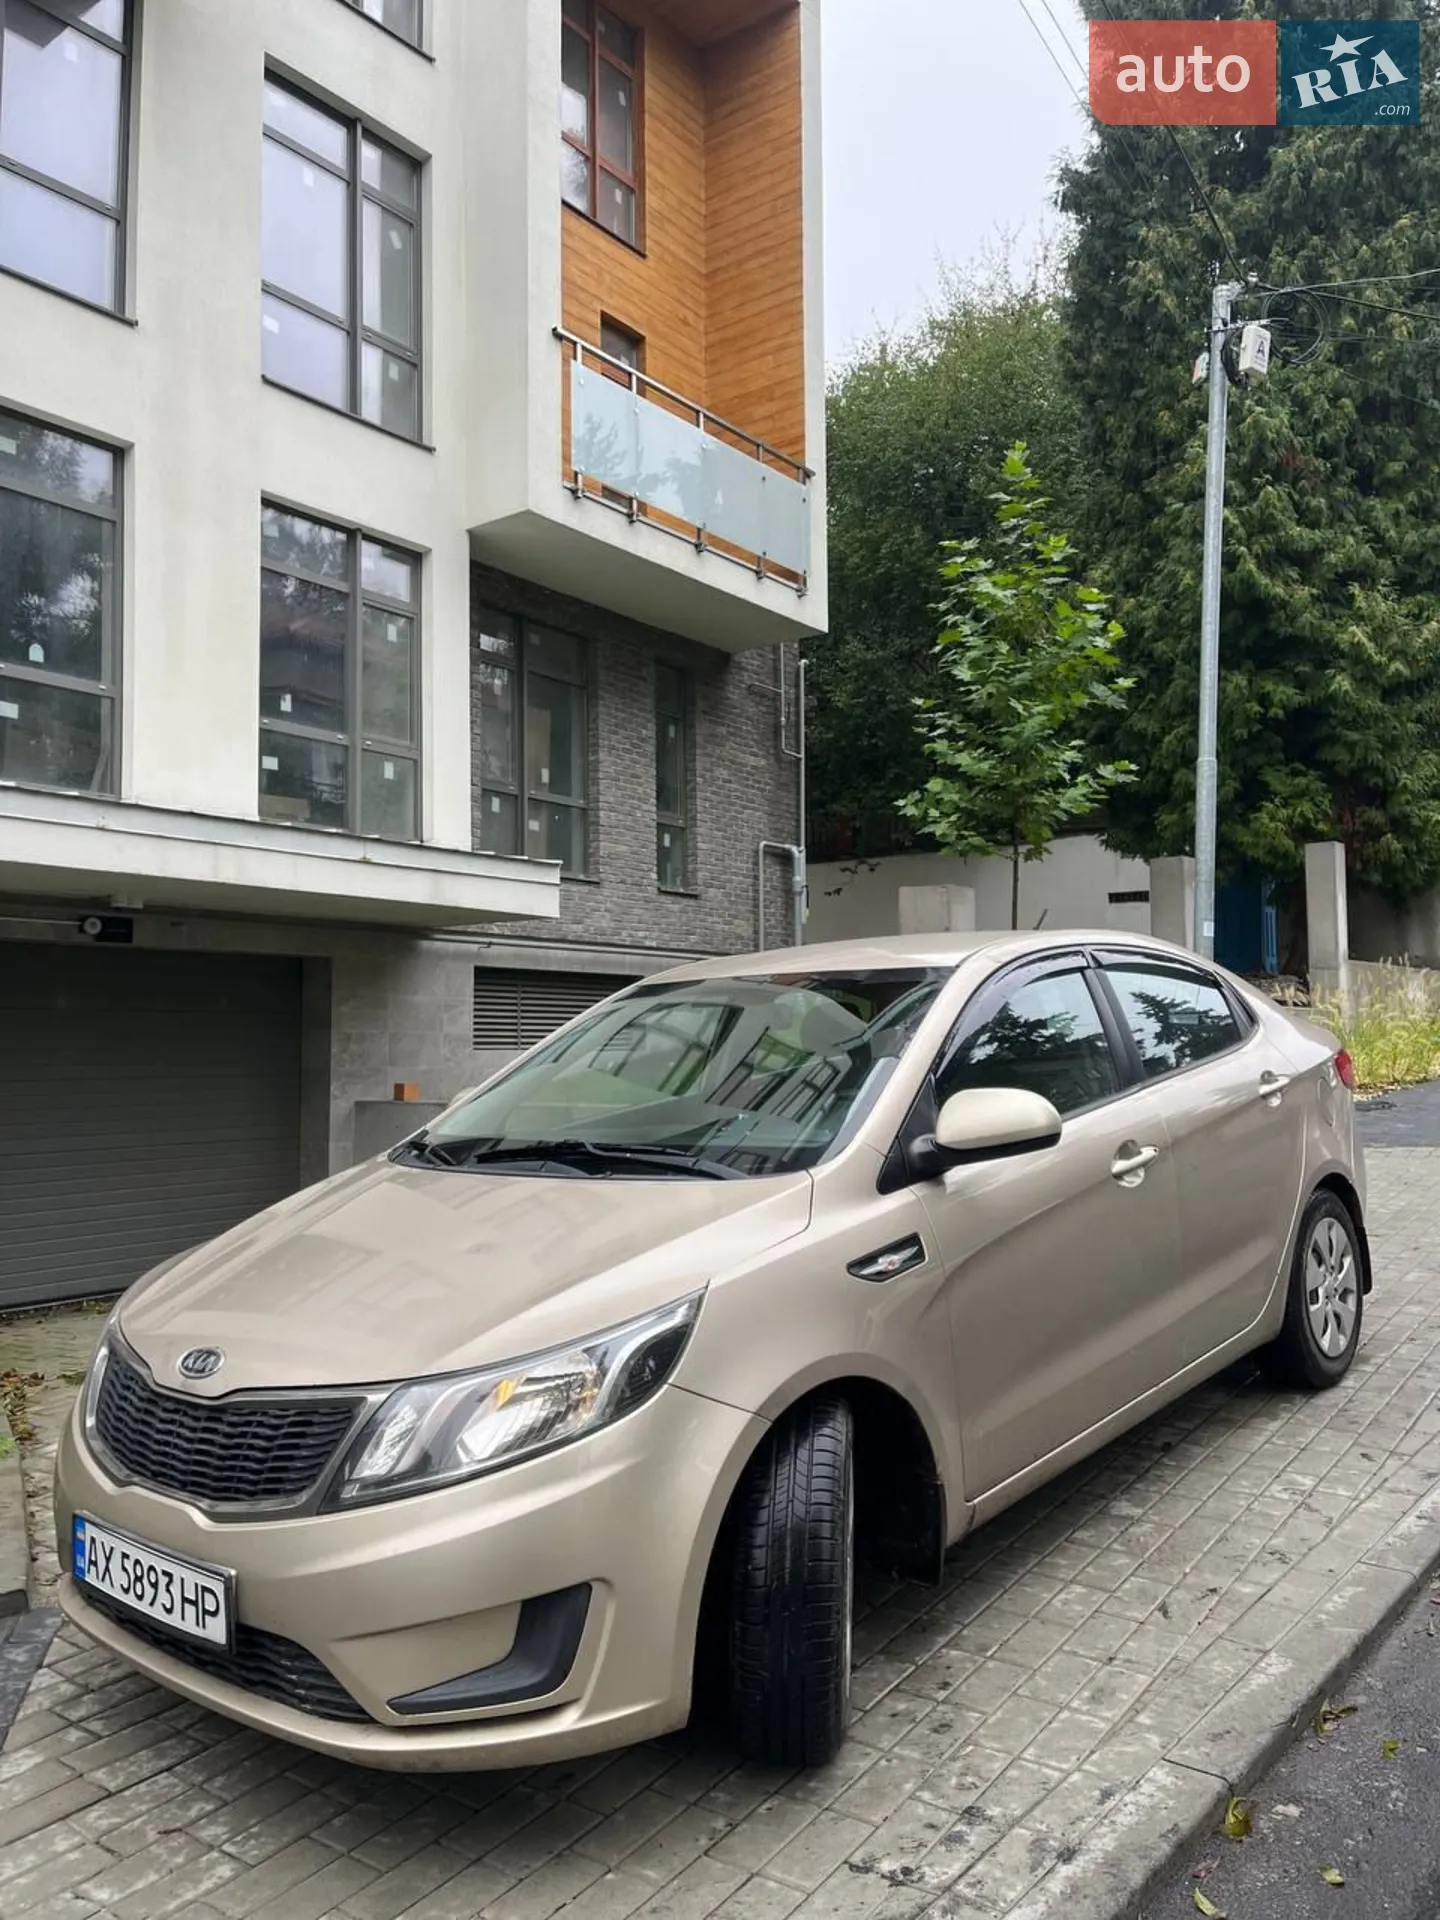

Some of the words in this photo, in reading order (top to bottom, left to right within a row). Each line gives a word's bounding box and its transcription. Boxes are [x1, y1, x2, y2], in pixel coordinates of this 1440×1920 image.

[183, 1351, 217, 1372] KIA
[87, 1535, 115, 1588] AX
[120, 1551, 175, 1615] 5893
[180, 1576, 220, 1630] HP
